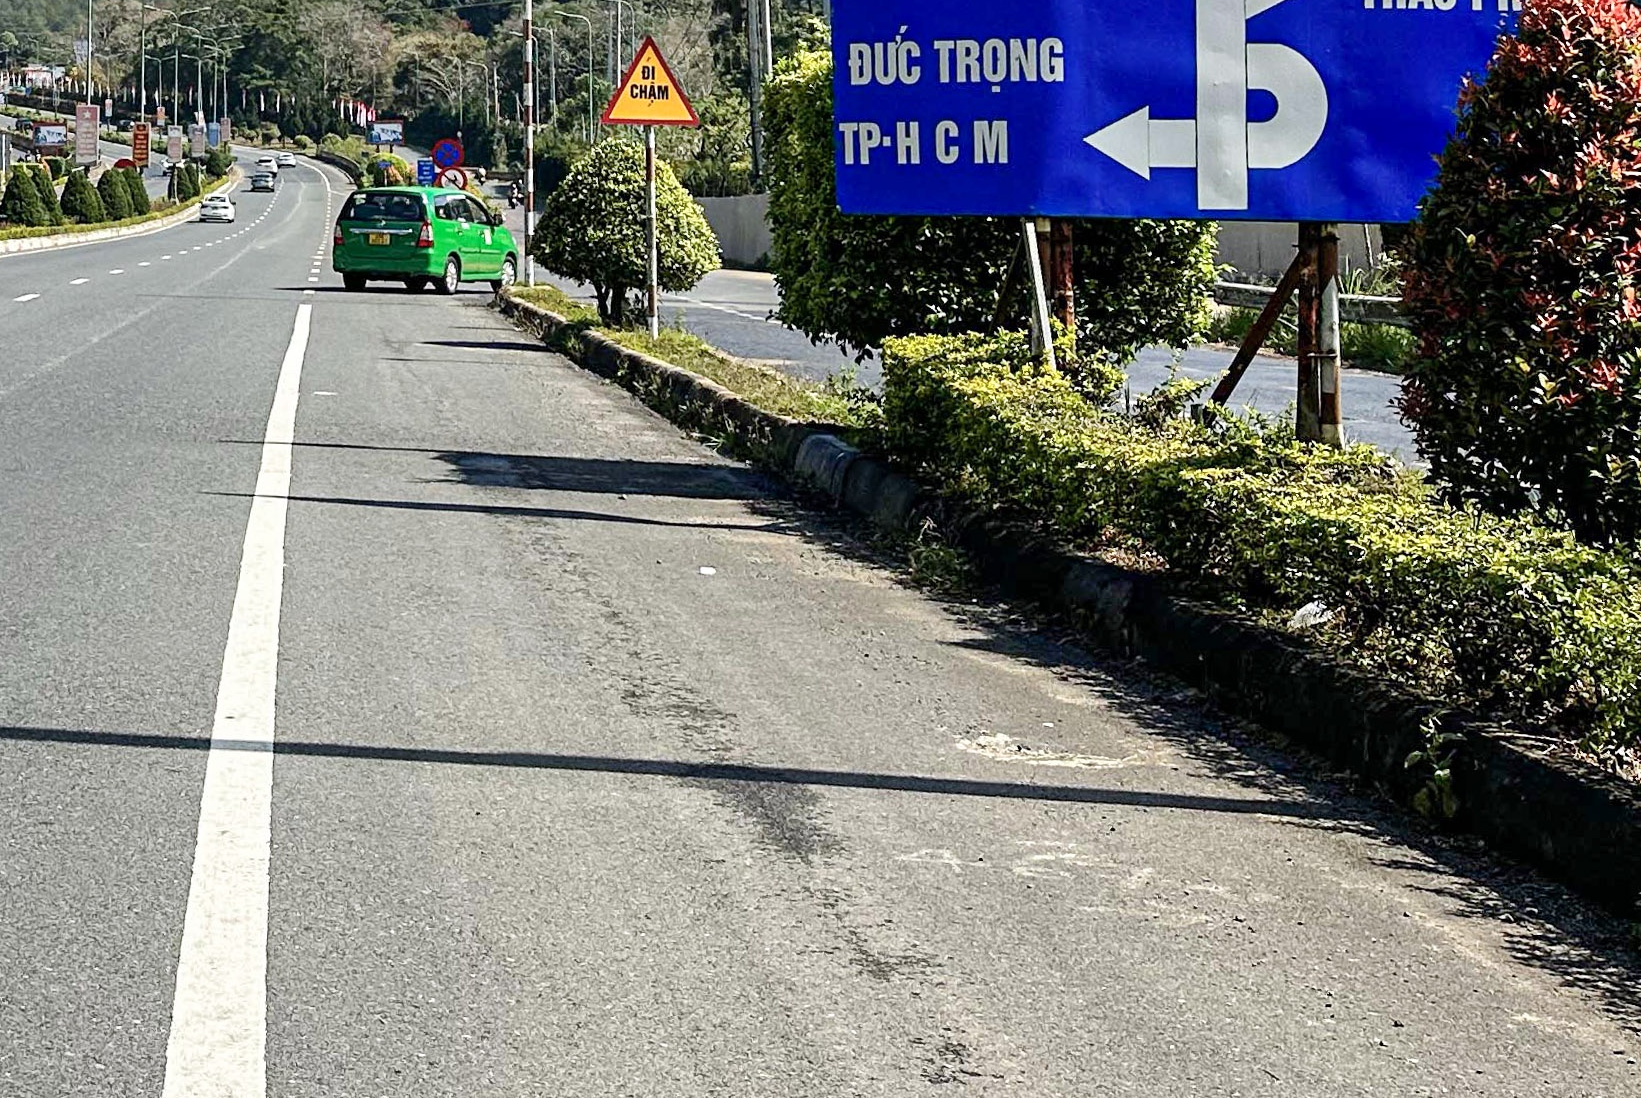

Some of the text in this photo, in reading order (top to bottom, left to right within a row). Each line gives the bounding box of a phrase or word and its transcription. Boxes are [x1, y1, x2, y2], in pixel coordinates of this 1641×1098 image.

[848, 25, 1065, 93] ĐỨC TRỌNG
[641, 65, 655, 80] ĐI
[630, 82, 669, 103] CHẬM
